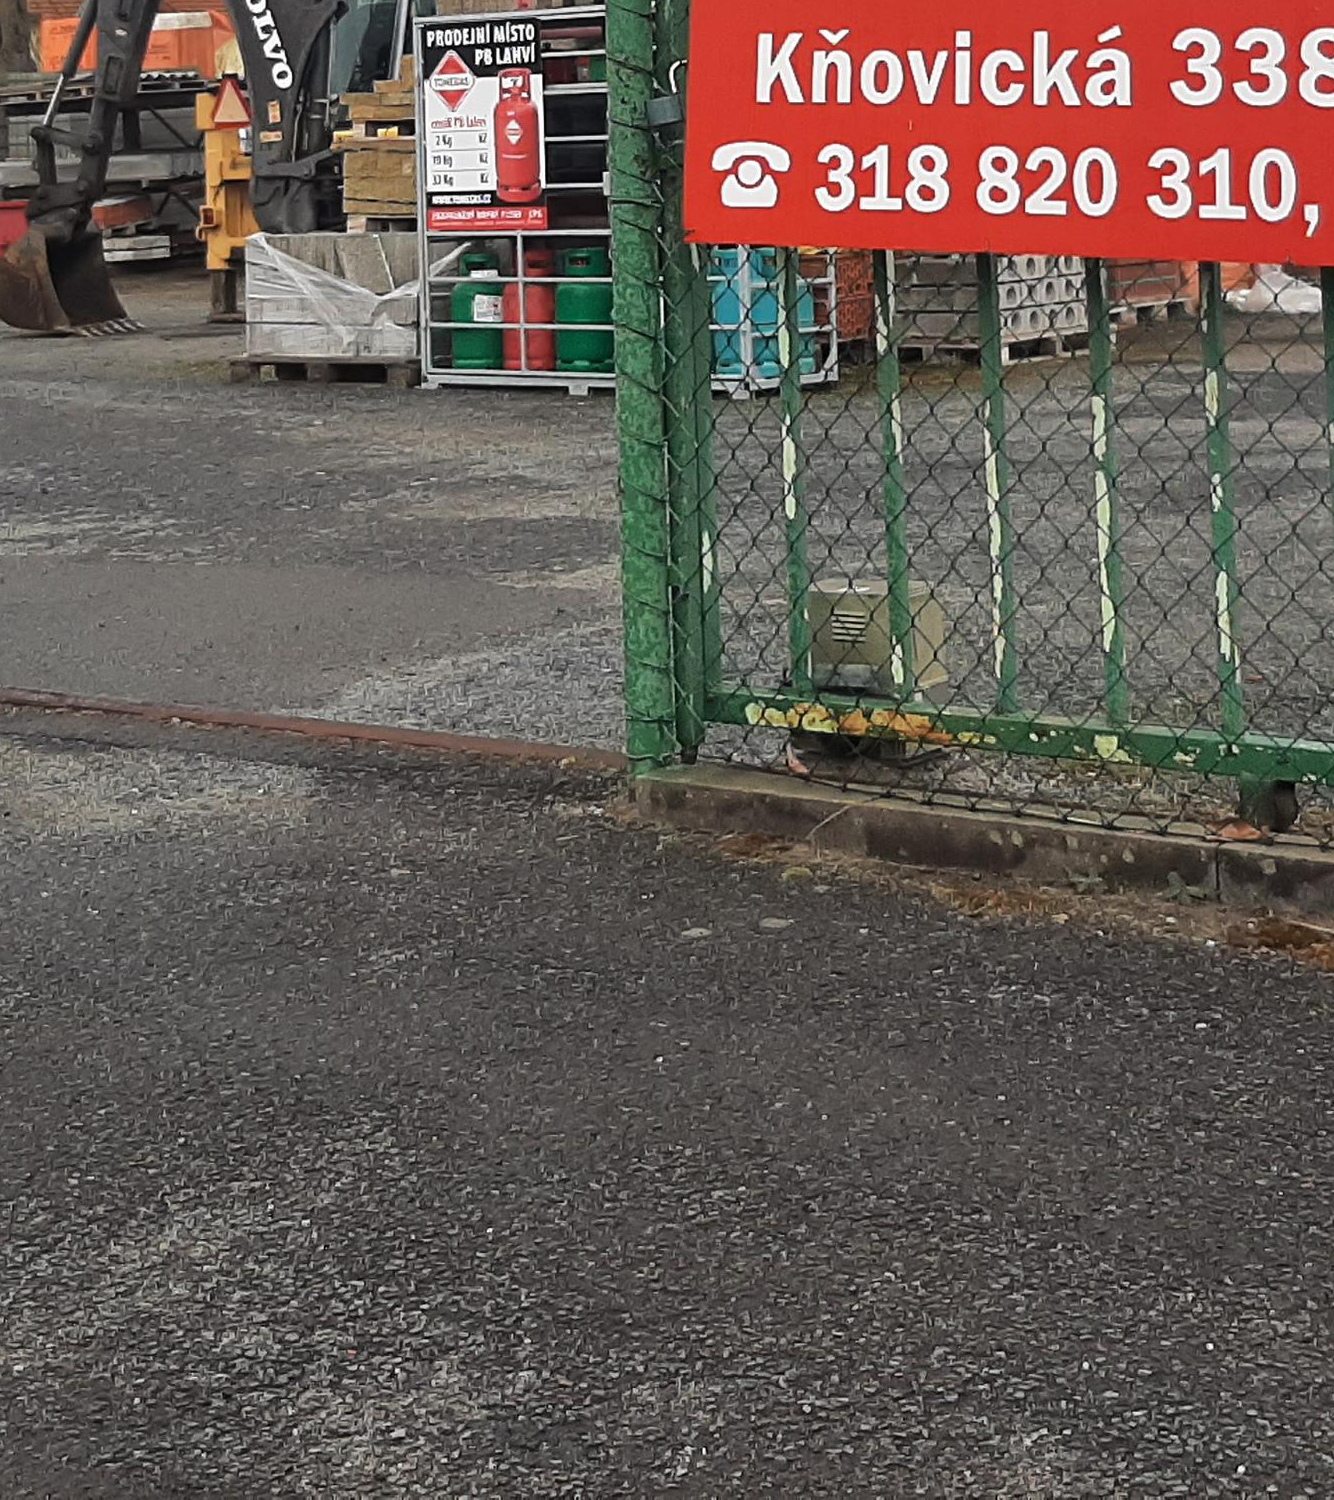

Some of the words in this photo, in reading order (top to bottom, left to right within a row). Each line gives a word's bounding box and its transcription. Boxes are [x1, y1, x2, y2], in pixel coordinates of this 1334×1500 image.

[427, 23, 490, 47] PRODEJNÍ
[493, 22, 535, 43] MÍSTO
[475, 48, 493, 65] PB
[495, 42, 535, 65] LAHVÍ
[757, 25, 1131, 106] Kňovická
[815, 144, 949, 212] 318
[977, 146, 1117, 216] 820
[1147, 148, 1318, 236] 310,
